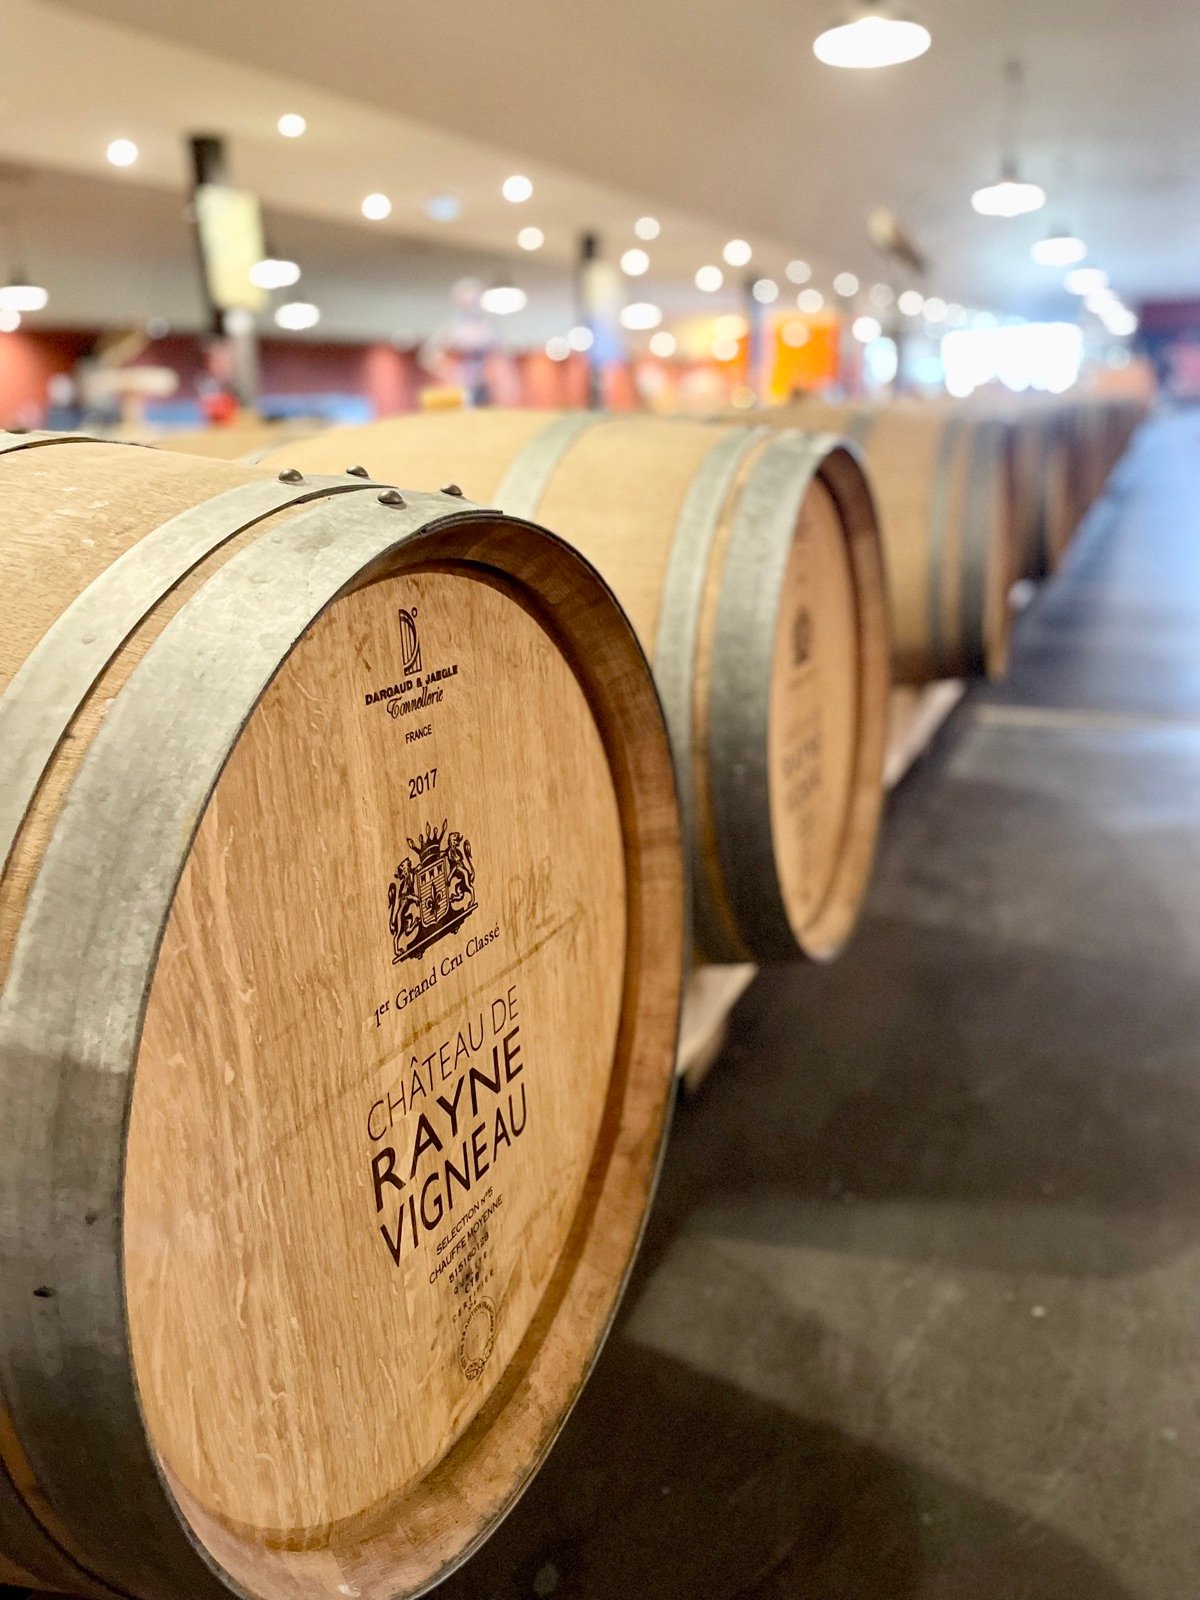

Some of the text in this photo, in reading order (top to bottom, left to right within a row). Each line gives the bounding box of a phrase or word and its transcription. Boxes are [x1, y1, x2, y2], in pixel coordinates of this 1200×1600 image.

[386, 686, 443, 719] Tonnellerie
[416, 677, 422, 687] &
[425, 665, 458, 685] JAEGLE
[405, 724, 432, 744] FRANCE
[408, 768, 438, 800] 2017
[373, 921, 500, 1028] 1er Grand Cru Classé
[367, 985, 519, 1141] CHÂTEAU DE
[371, 1025, 524, 1213] RAYNE
[380, 1082, 527, 1268] VIGNEAU
[429, 1194, 503, 1284] CHAUFFE MOYENNE
[436, 1201, 480, 1255] SELECTION
